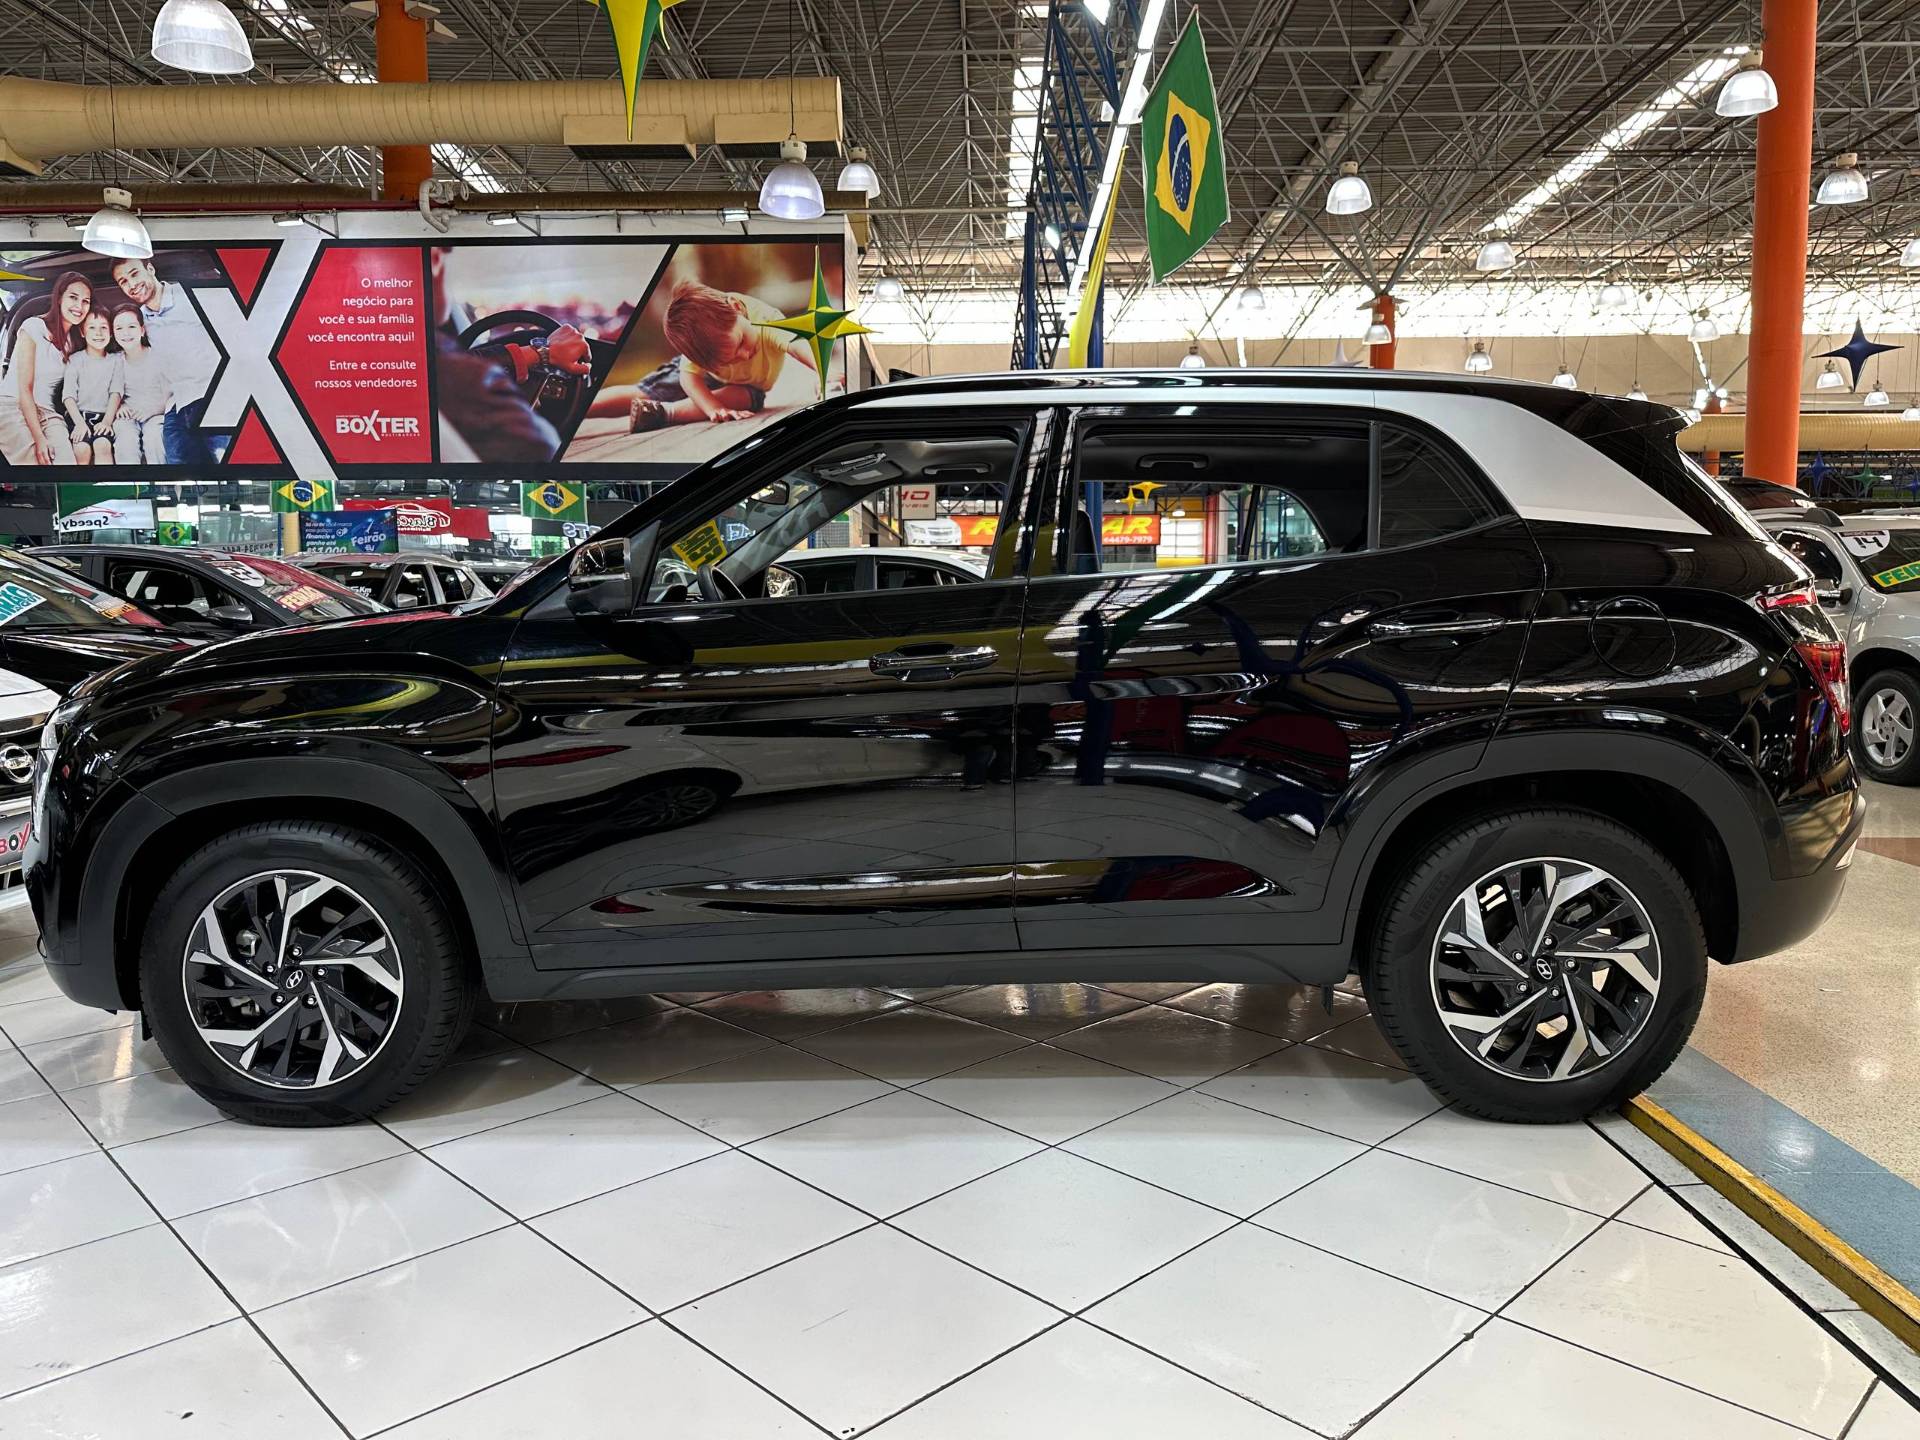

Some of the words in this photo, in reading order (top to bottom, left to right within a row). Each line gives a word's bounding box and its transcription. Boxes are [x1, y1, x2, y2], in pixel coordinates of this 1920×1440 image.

[361, 278, 371, 288] O
[374, 277, 413, 288] melhor
[343, 296, 387, 308] negócio
[390, 298, 414, 308] para
[319, 314, 345, 324] você
[348, 316, 354, 324] e
[357, 316, 376, 324] sua
[378, 313, 414, 324] família
[308, 332, 334, 343] você
[336, 332, 386, 342] encontra
[388, 331, 415, 344] aqui!
[329, 360, 358, 370] Entre
[360, 362, 367, 370] e
[370, 360, 417, 370] consulte
[315, 379, 352, 388] nossos
[354, 378, 418, 388] vendedores
[336, 409, 420, 441] BOXTER
[351, 532, 386, 547] Feirão
